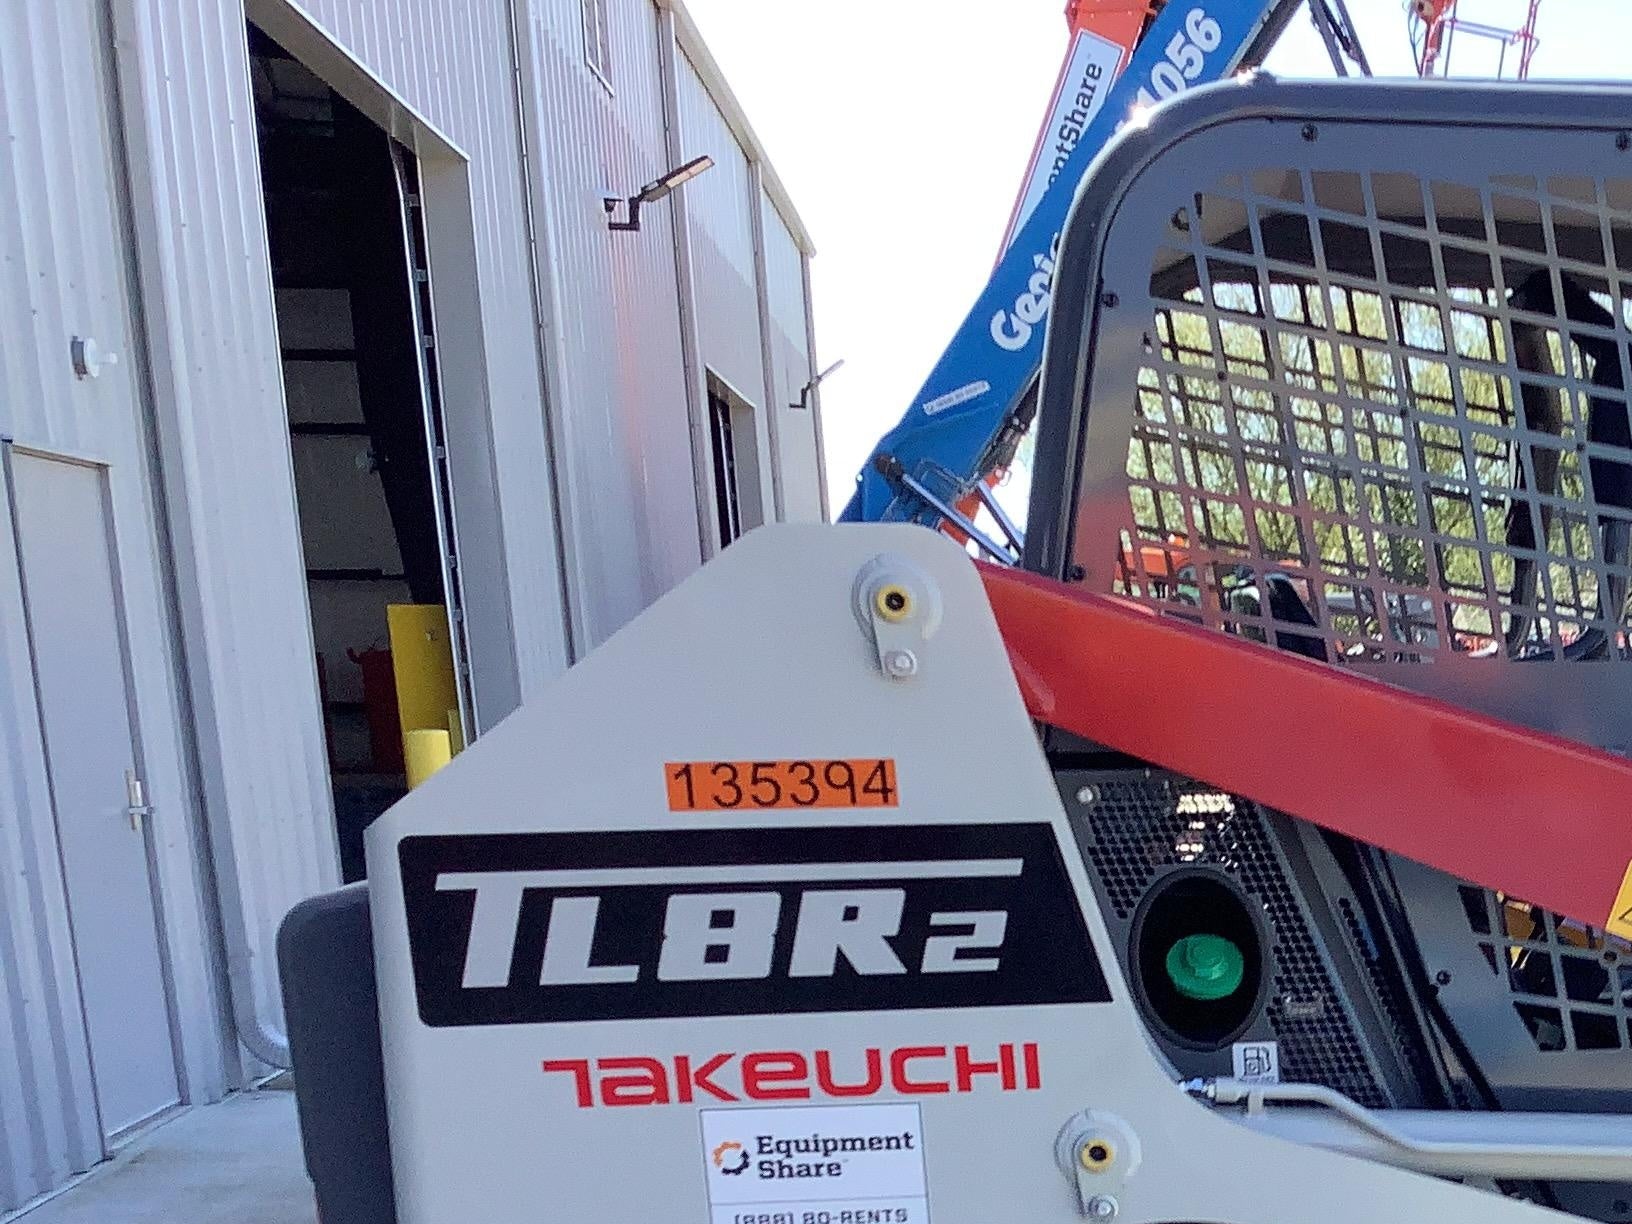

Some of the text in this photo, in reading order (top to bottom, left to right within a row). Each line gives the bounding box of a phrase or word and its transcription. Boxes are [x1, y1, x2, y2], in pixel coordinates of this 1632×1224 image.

[672, 759, 893, 809] 135394
[756, 1131, 914, 1158] Equipment
[758, 1161, 842, 1180] Share
